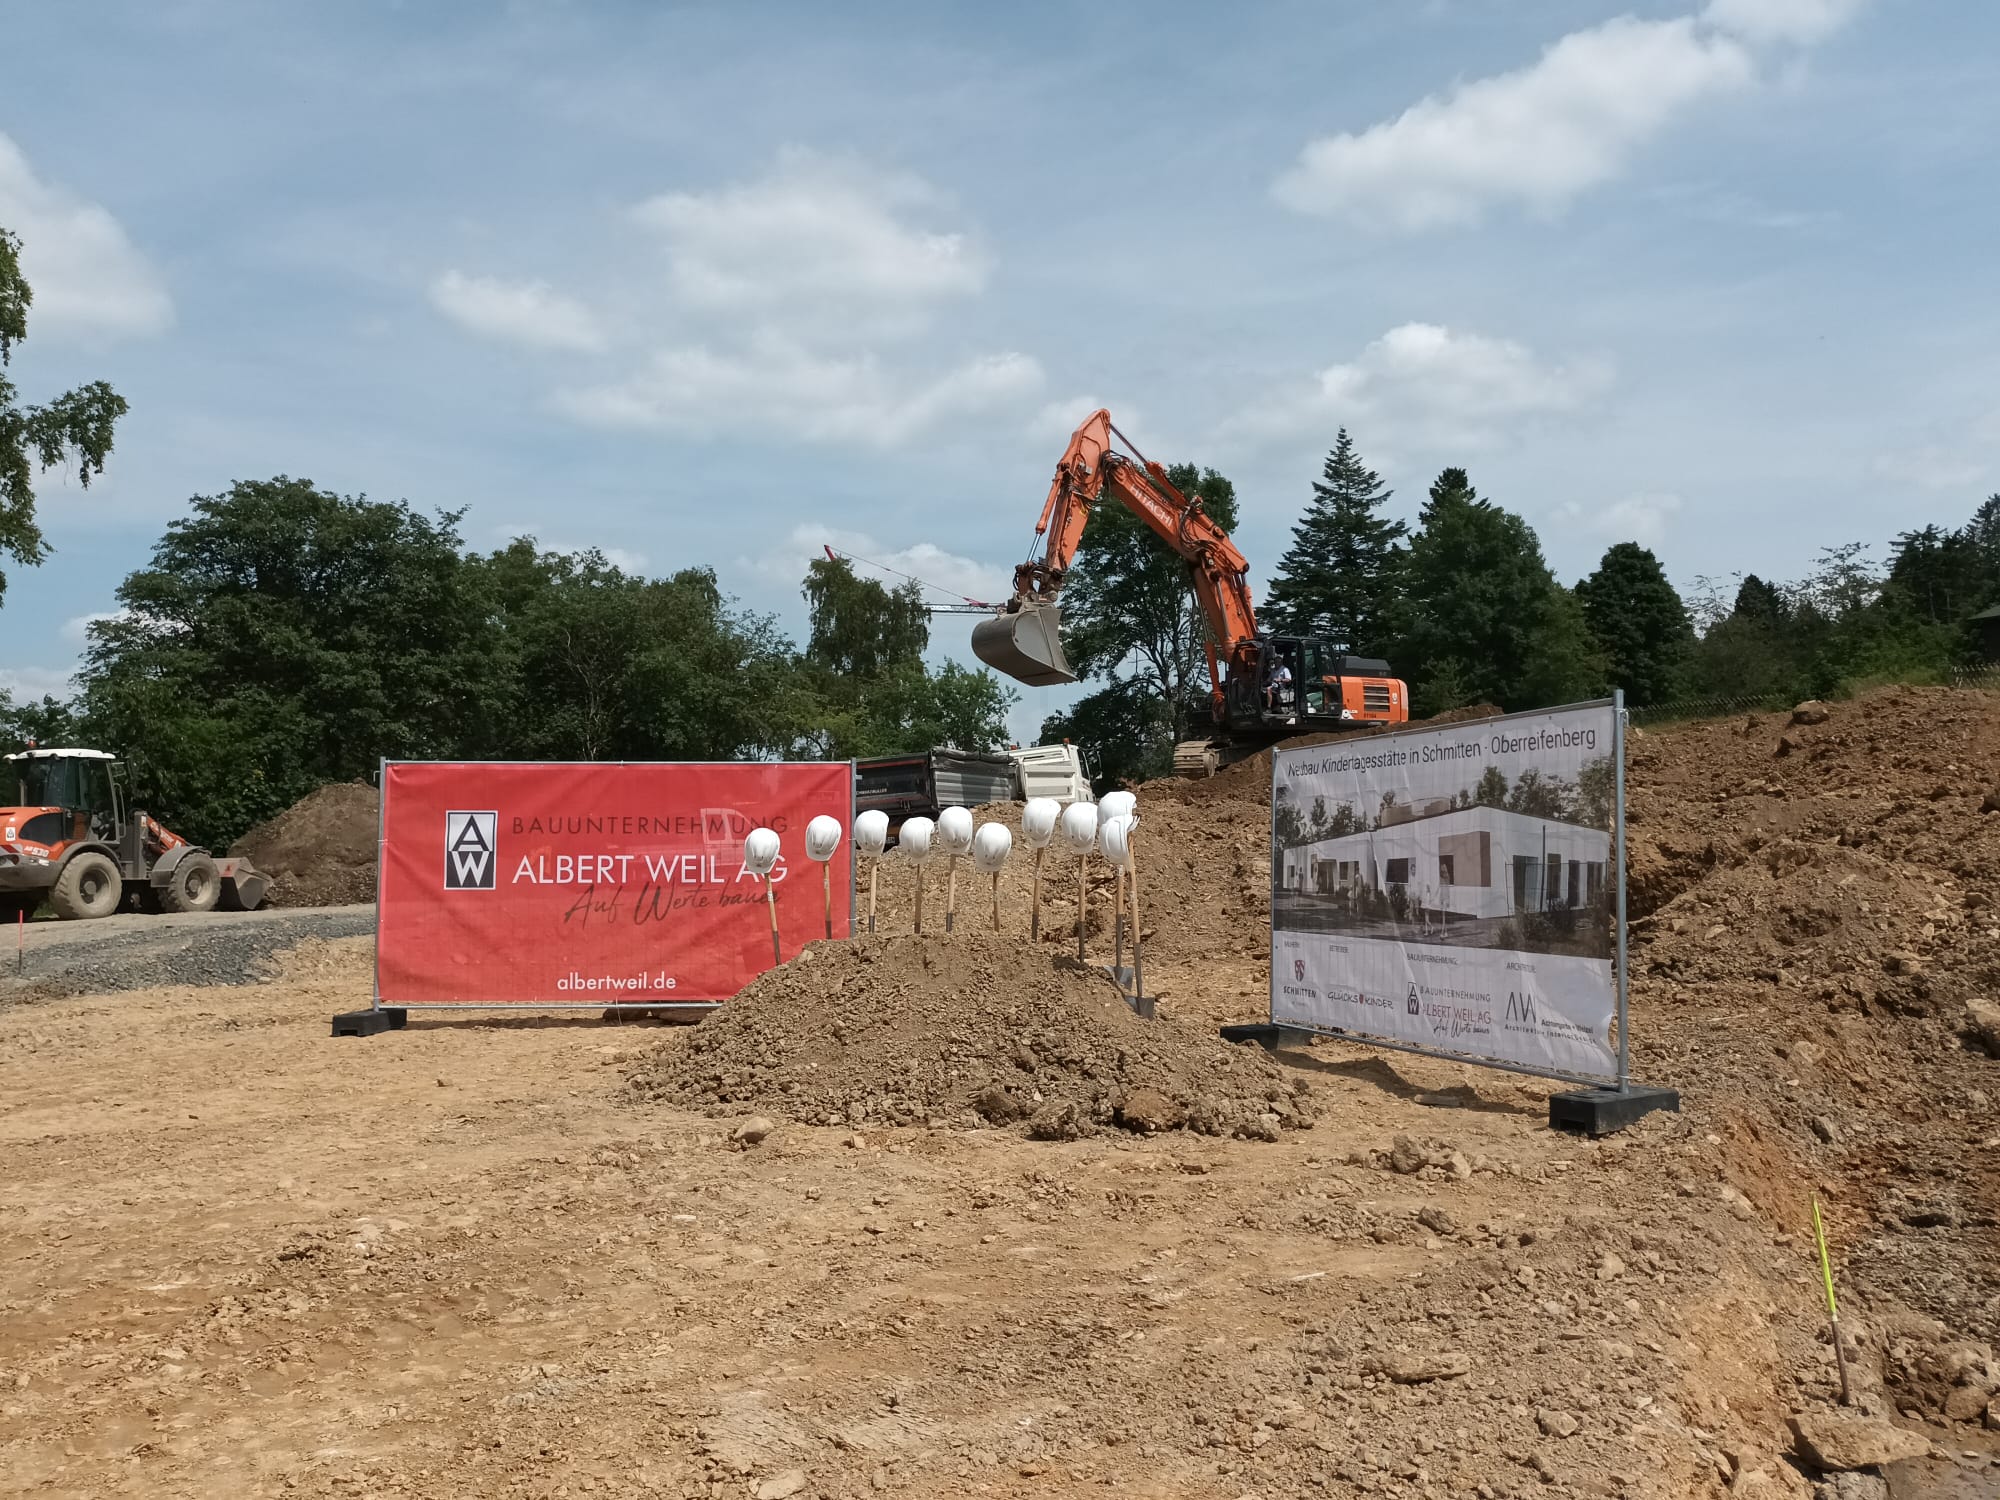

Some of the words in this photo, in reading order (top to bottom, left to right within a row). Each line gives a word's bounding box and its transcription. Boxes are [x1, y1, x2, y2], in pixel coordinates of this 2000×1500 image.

[1130, 484, 1174, 527] HITACHI
[1288, 760, 1320, 777] Neubau
[1321, 751, 1407, 774] Kindertagesstätte
[1409, 748, 1420, 764] in
[1422, 742, 1481, 763] Schmitten
[1491, 729, 1596, 755] Oberreifenberg
[511, 815, 788, 836] BAUUNTERNEHMUNG
[511, 854, 635, 885] ALBERT
[644, 854, 726, 884] WEIL
[735, 853, 788, 883] AG
[563, 883, 624, 929] Auf
[634, 878, 722, 926] Werte
[557, 970, 677, 991] albertweil.de
[1283, 985, 1316, 999] SCHMITTEN
